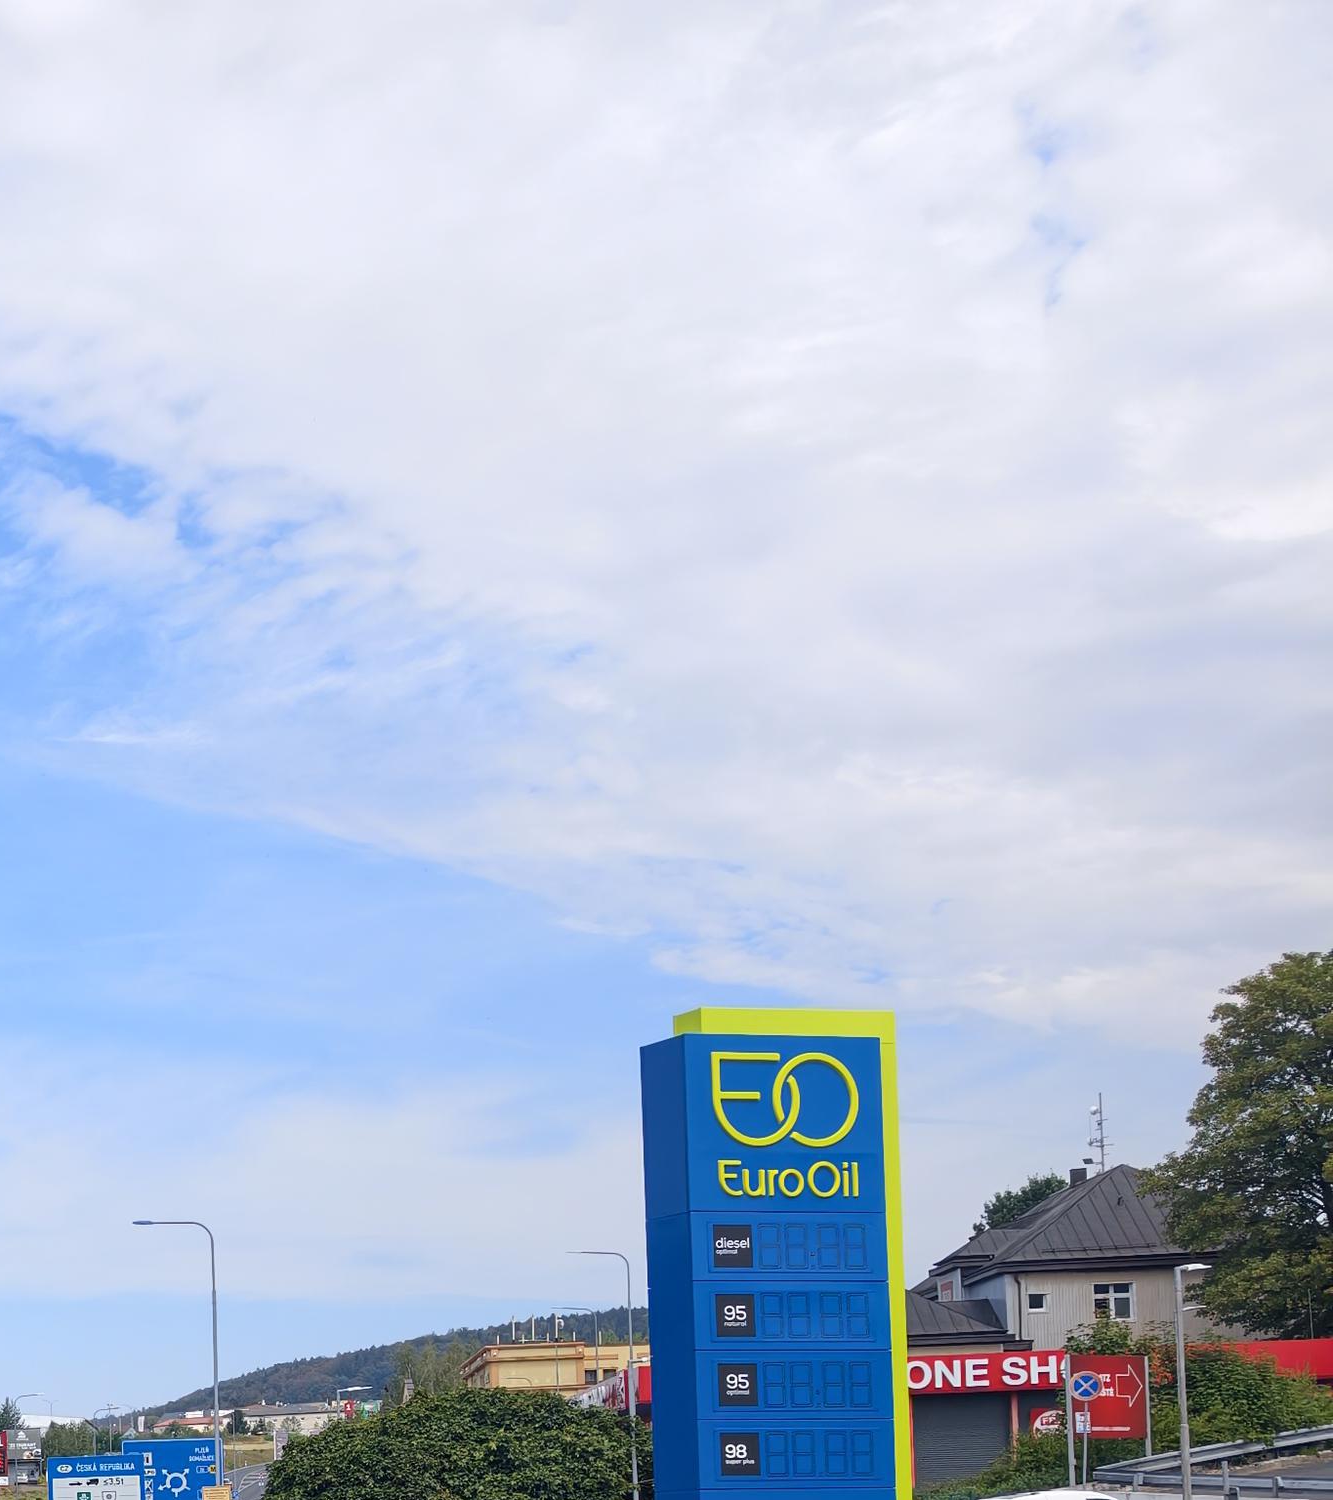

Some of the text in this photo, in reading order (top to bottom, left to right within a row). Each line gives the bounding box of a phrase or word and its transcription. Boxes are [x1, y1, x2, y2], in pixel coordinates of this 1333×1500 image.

[717, 1159, 859, 1197] EuroOil
[715, 1237, 750, 1248] diesel
[724, 1305, 747, 1321] 95
[726, 1374, 749, 1389] 95
[907, 1358, 989, 1390] ONE
[725, 1444, 747, 1458] 98
[76, 1462, 97, 1472] ČESKÁ
[100, 1463, 135, 1472] REPUBLIKA
